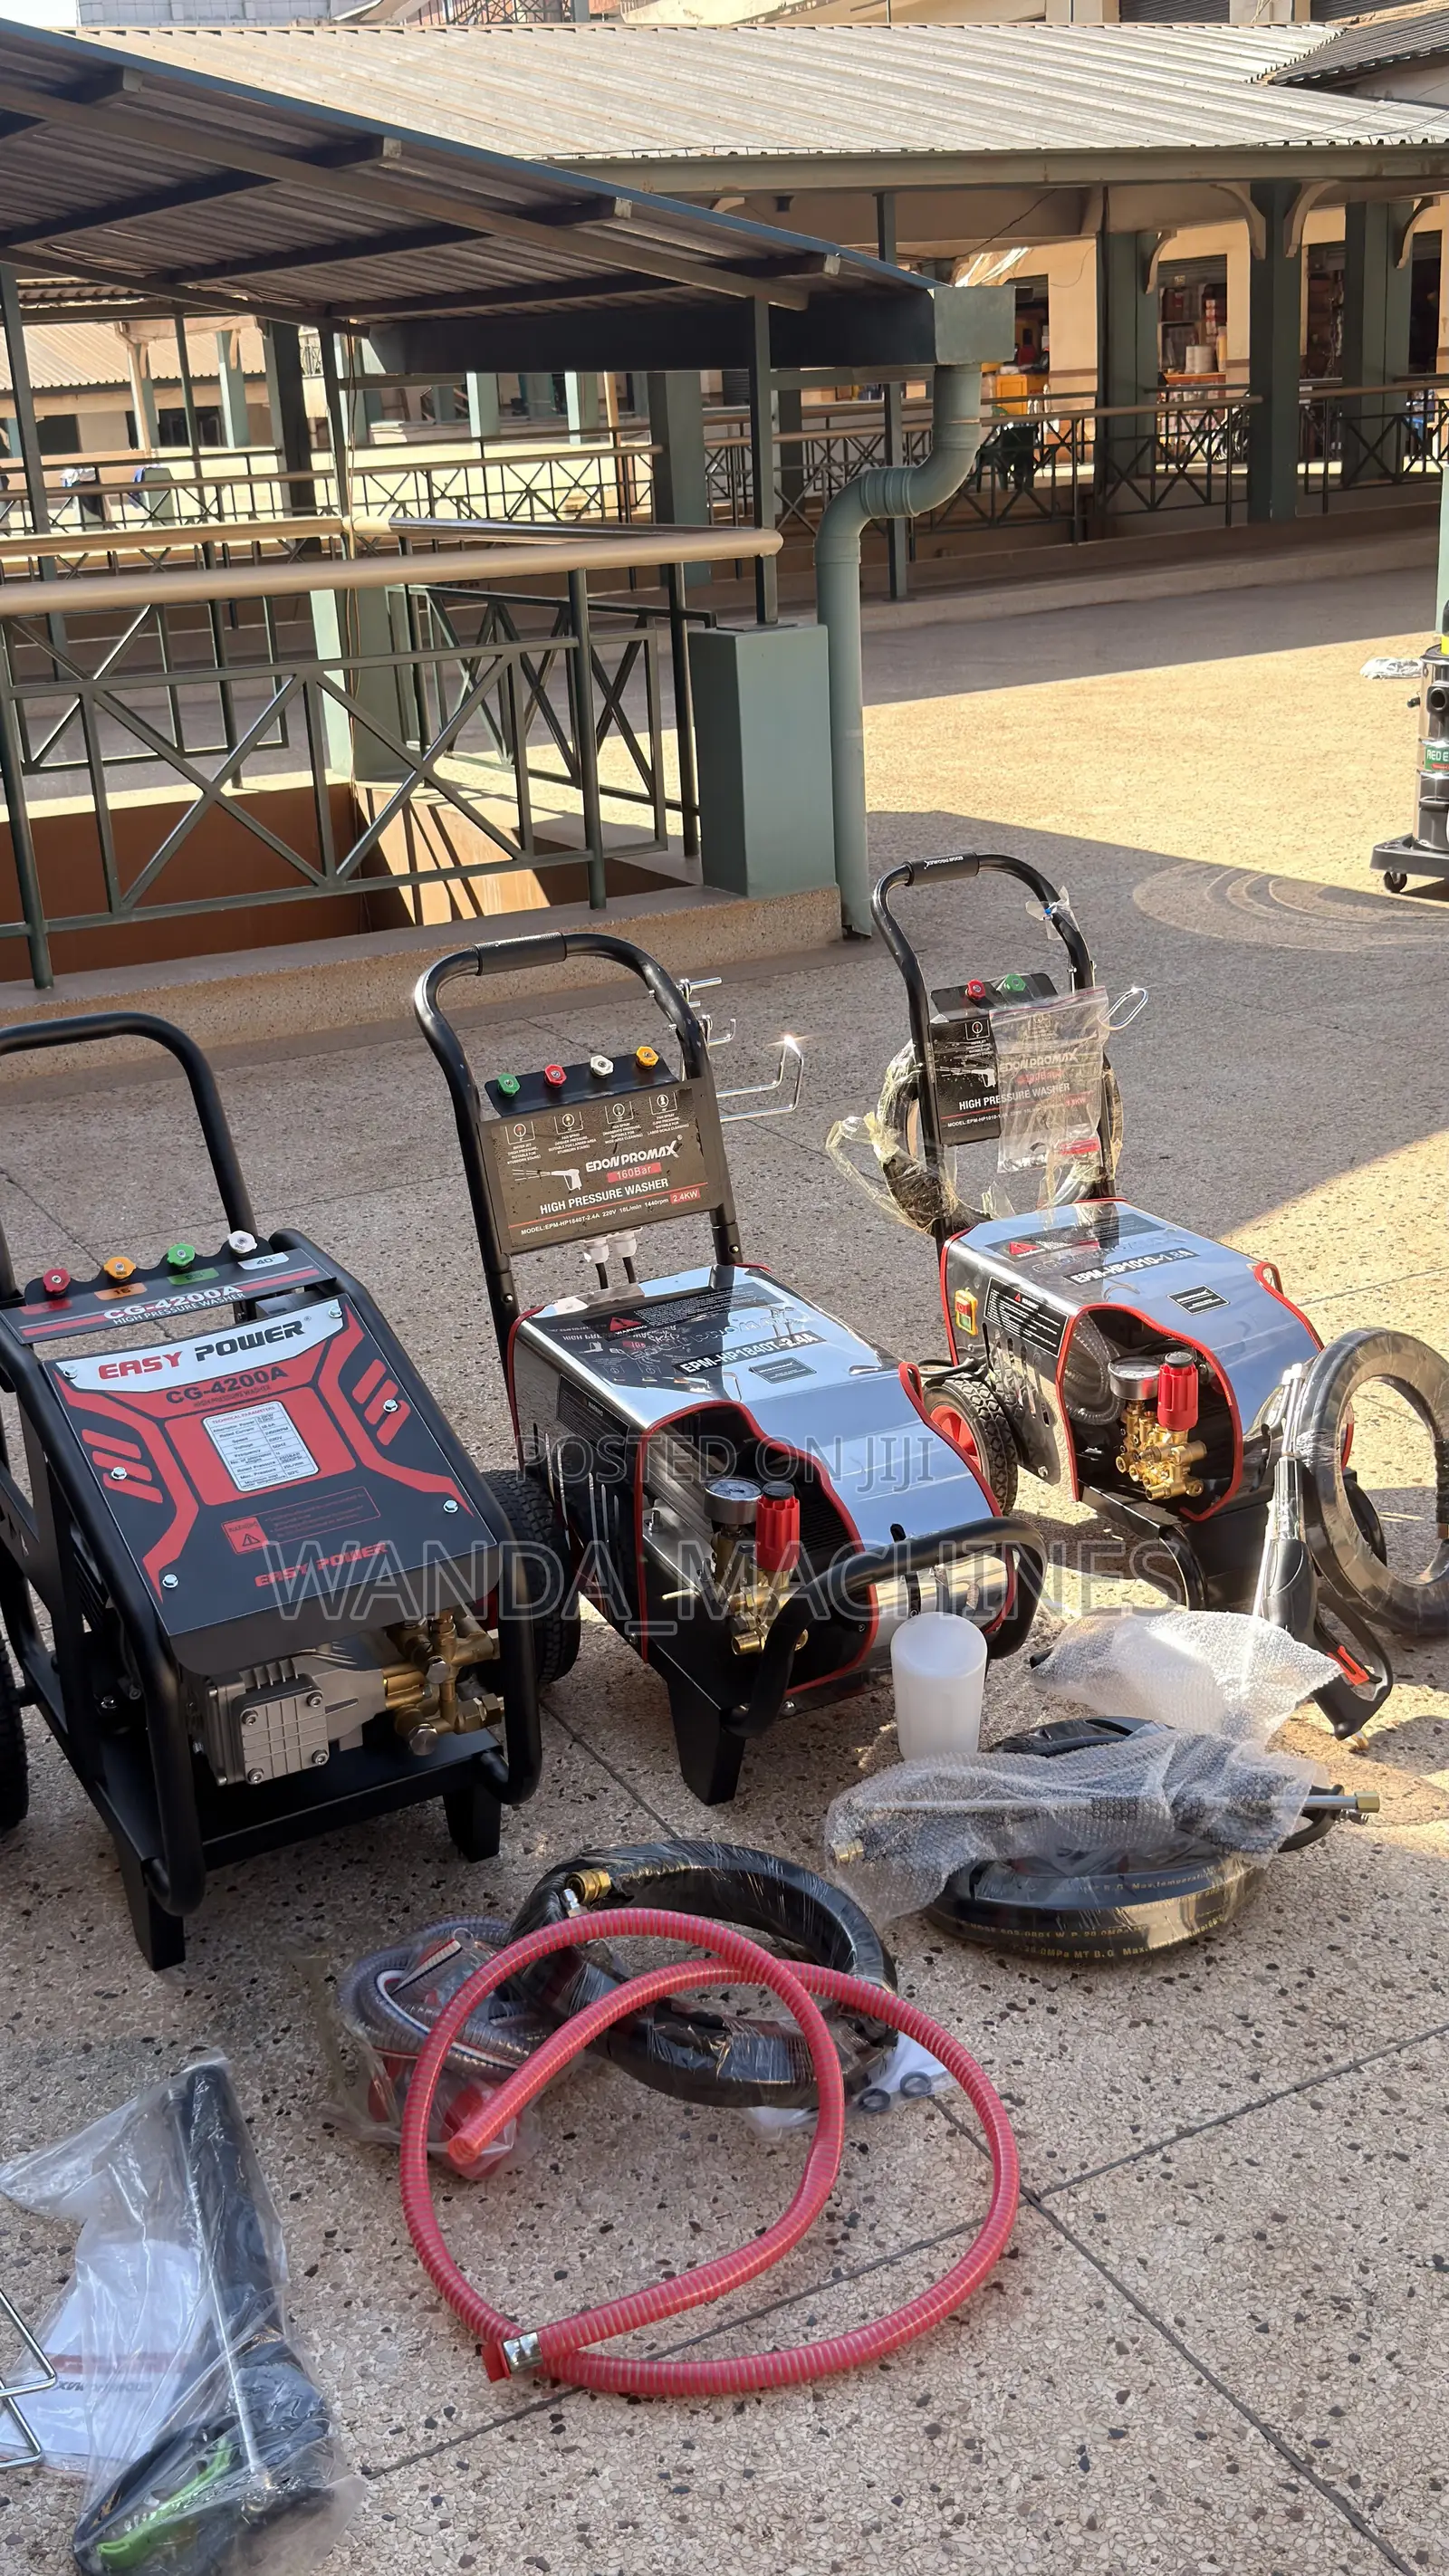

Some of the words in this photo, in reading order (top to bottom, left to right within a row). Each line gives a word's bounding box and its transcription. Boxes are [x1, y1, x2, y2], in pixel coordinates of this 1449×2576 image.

[1426, 750, 1441, 761] RED
[958, 1097, 982, 1111] HIGH
[983, 1088, 1031, 1106] PRESSURE
[1032, 1082, 1070, 1097] WASHER
[617, 1164, 652, 1181] 160Bar
[540, 1201, 566, 1215] HIGH
[568, 1187, 623, 1209] PRESSURE
[624, 1178, 669, 1196] WASHER
[601, 1209, 617, 1218] 220V
[672, 1190, 699, 1202] 2.4KW
[103, 1286, 244, 1321] CG-4200A
[113, 1312, 142, 1326] HIGH
[143, 1302, 198, 1321] PRESSURE
[198, 1292, 246, 1310] WASHER
[98, 1351, 183, 1380] EASY
[195, 1320, 305, 1363] POWER
[166, 1366, 289, 1404] CG-4200A
[254, 1563, 309, 1587] EASY
[315, 1542, 389, 1570] POWER
